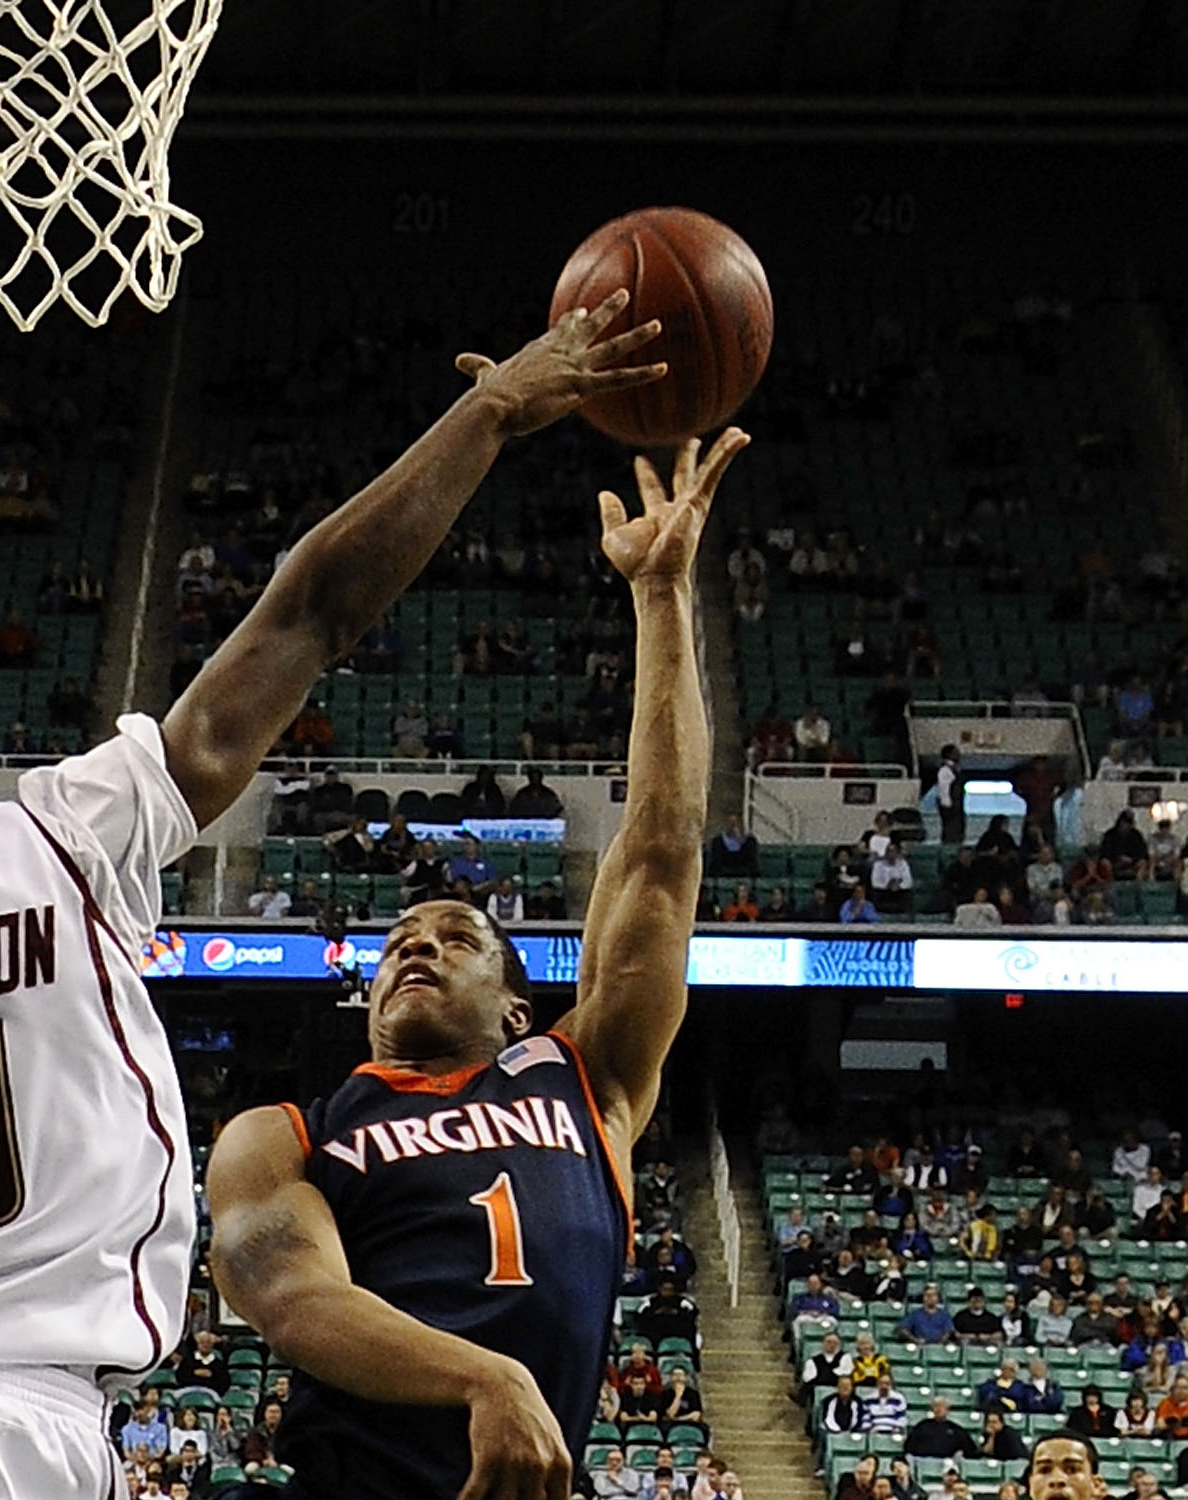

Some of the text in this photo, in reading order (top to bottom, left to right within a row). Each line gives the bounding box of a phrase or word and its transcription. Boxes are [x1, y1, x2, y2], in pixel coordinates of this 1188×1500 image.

[236, 946, 283, 964] pepsi
[321, 1097, 587, 1174] VIRGINIA
[468, 1171, 534, 1286] 1
